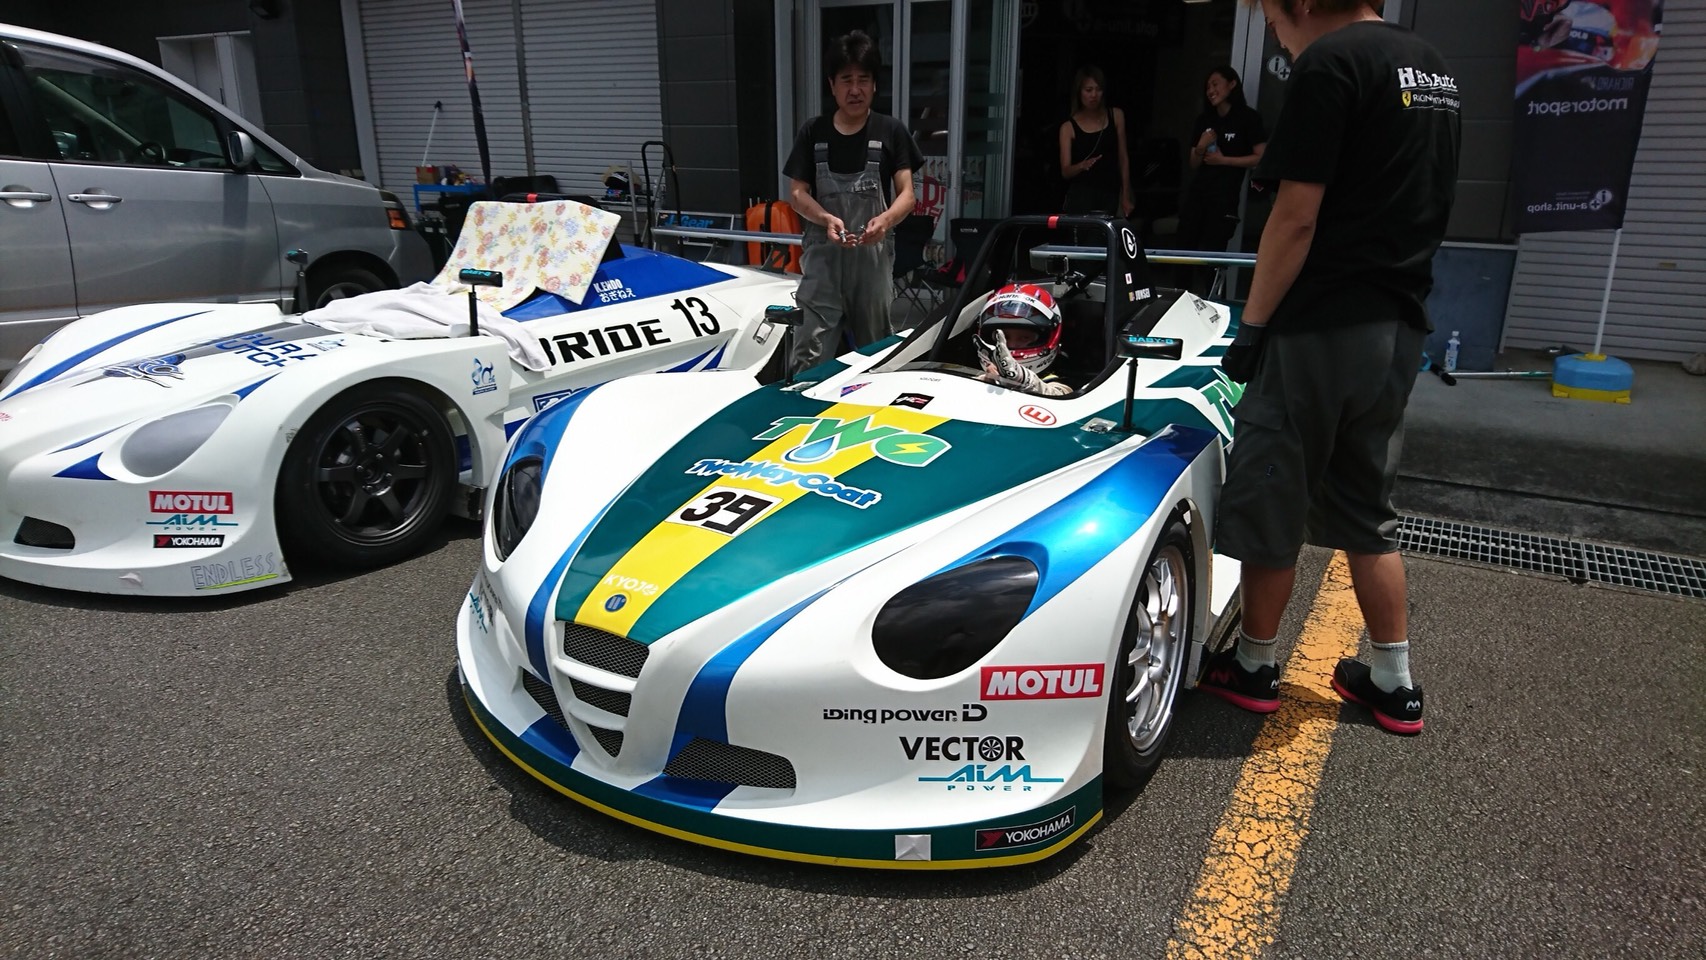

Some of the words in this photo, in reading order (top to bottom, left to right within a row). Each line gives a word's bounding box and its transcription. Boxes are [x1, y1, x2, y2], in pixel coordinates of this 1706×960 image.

[598, 288, 636, 303] おぎねえ
[670, 296, 720, 338] 13
[752, 415, 951, 467] TWO
[154, 494, 230, 511] MOTUL
[680, 491, 773, 536] 39
[171, 537, 220, 546] YOKOHAMA
[191, 552, 276, 588] ENDLESS
[986, 668, 1100, 696] MOTUL
[899, 735, 1026, 762] VECTOR
[1005, 814, 1071, 844] YOKOHAMA
